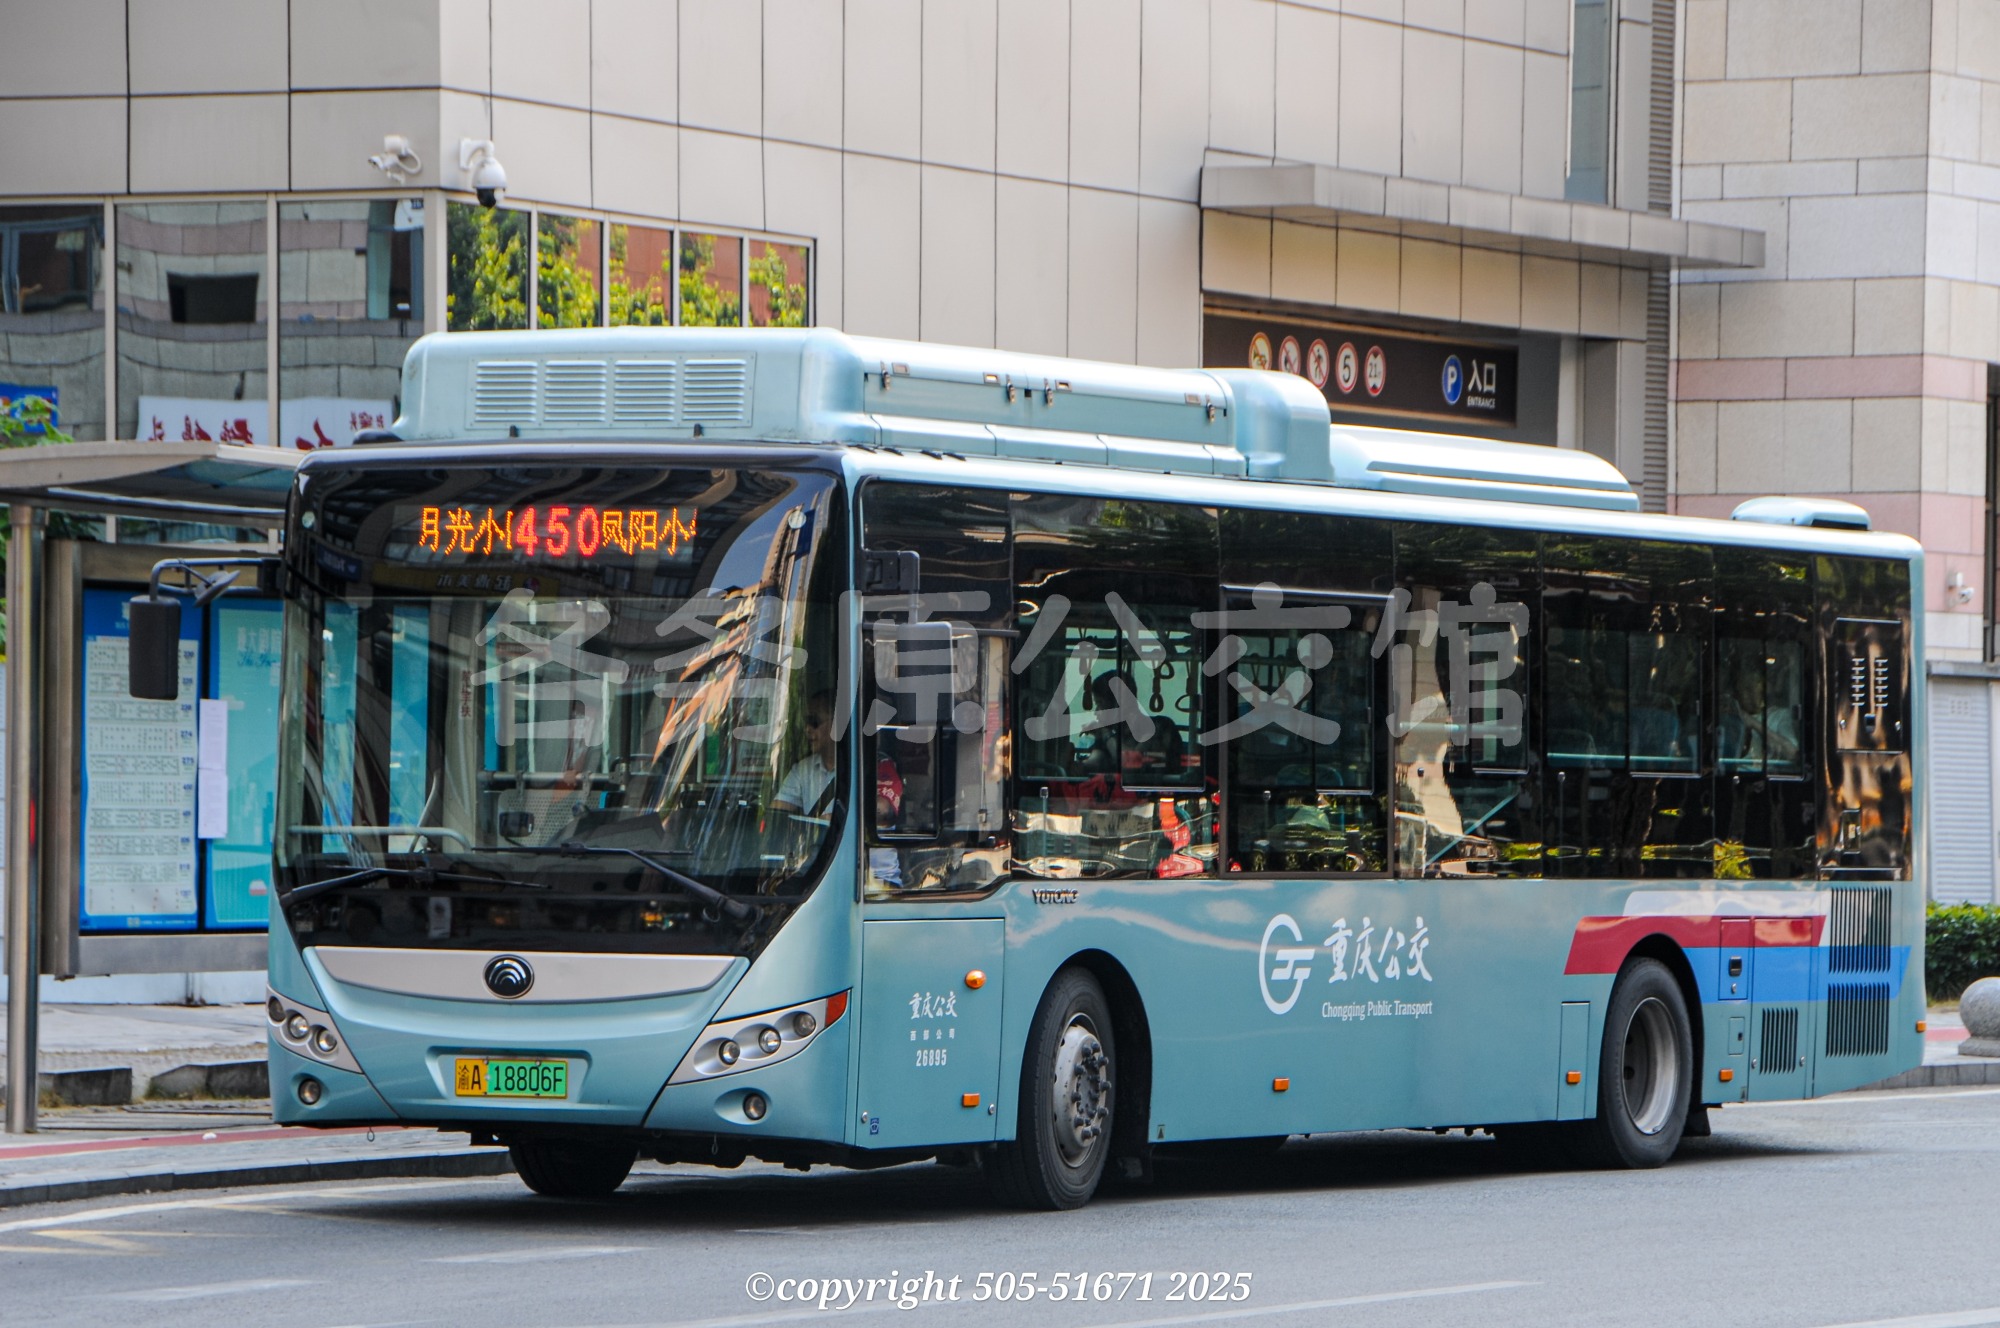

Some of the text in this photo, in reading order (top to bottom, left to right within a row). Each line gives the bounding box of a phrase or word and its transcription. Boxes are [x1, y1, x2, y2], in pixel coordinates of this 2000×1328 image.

[1343, 355, 1351, 383] 5
[1447, 365, 1458, 393] P
[1467, 359, 1496, 394] 入口
[1467, 396, 1496, 409] ENTRANCE
[516, 507, 600, 556] 450
[1032, 889, 1079, 904] YUTONG
[1323, 916, 1433, 984] 重庆公交
[909, 991, 958, 1020] 重庆公交
[1322, 1000, 1433, 1021] Chongqing Public Transport
[916, 1048, 948, 1067] 26895
